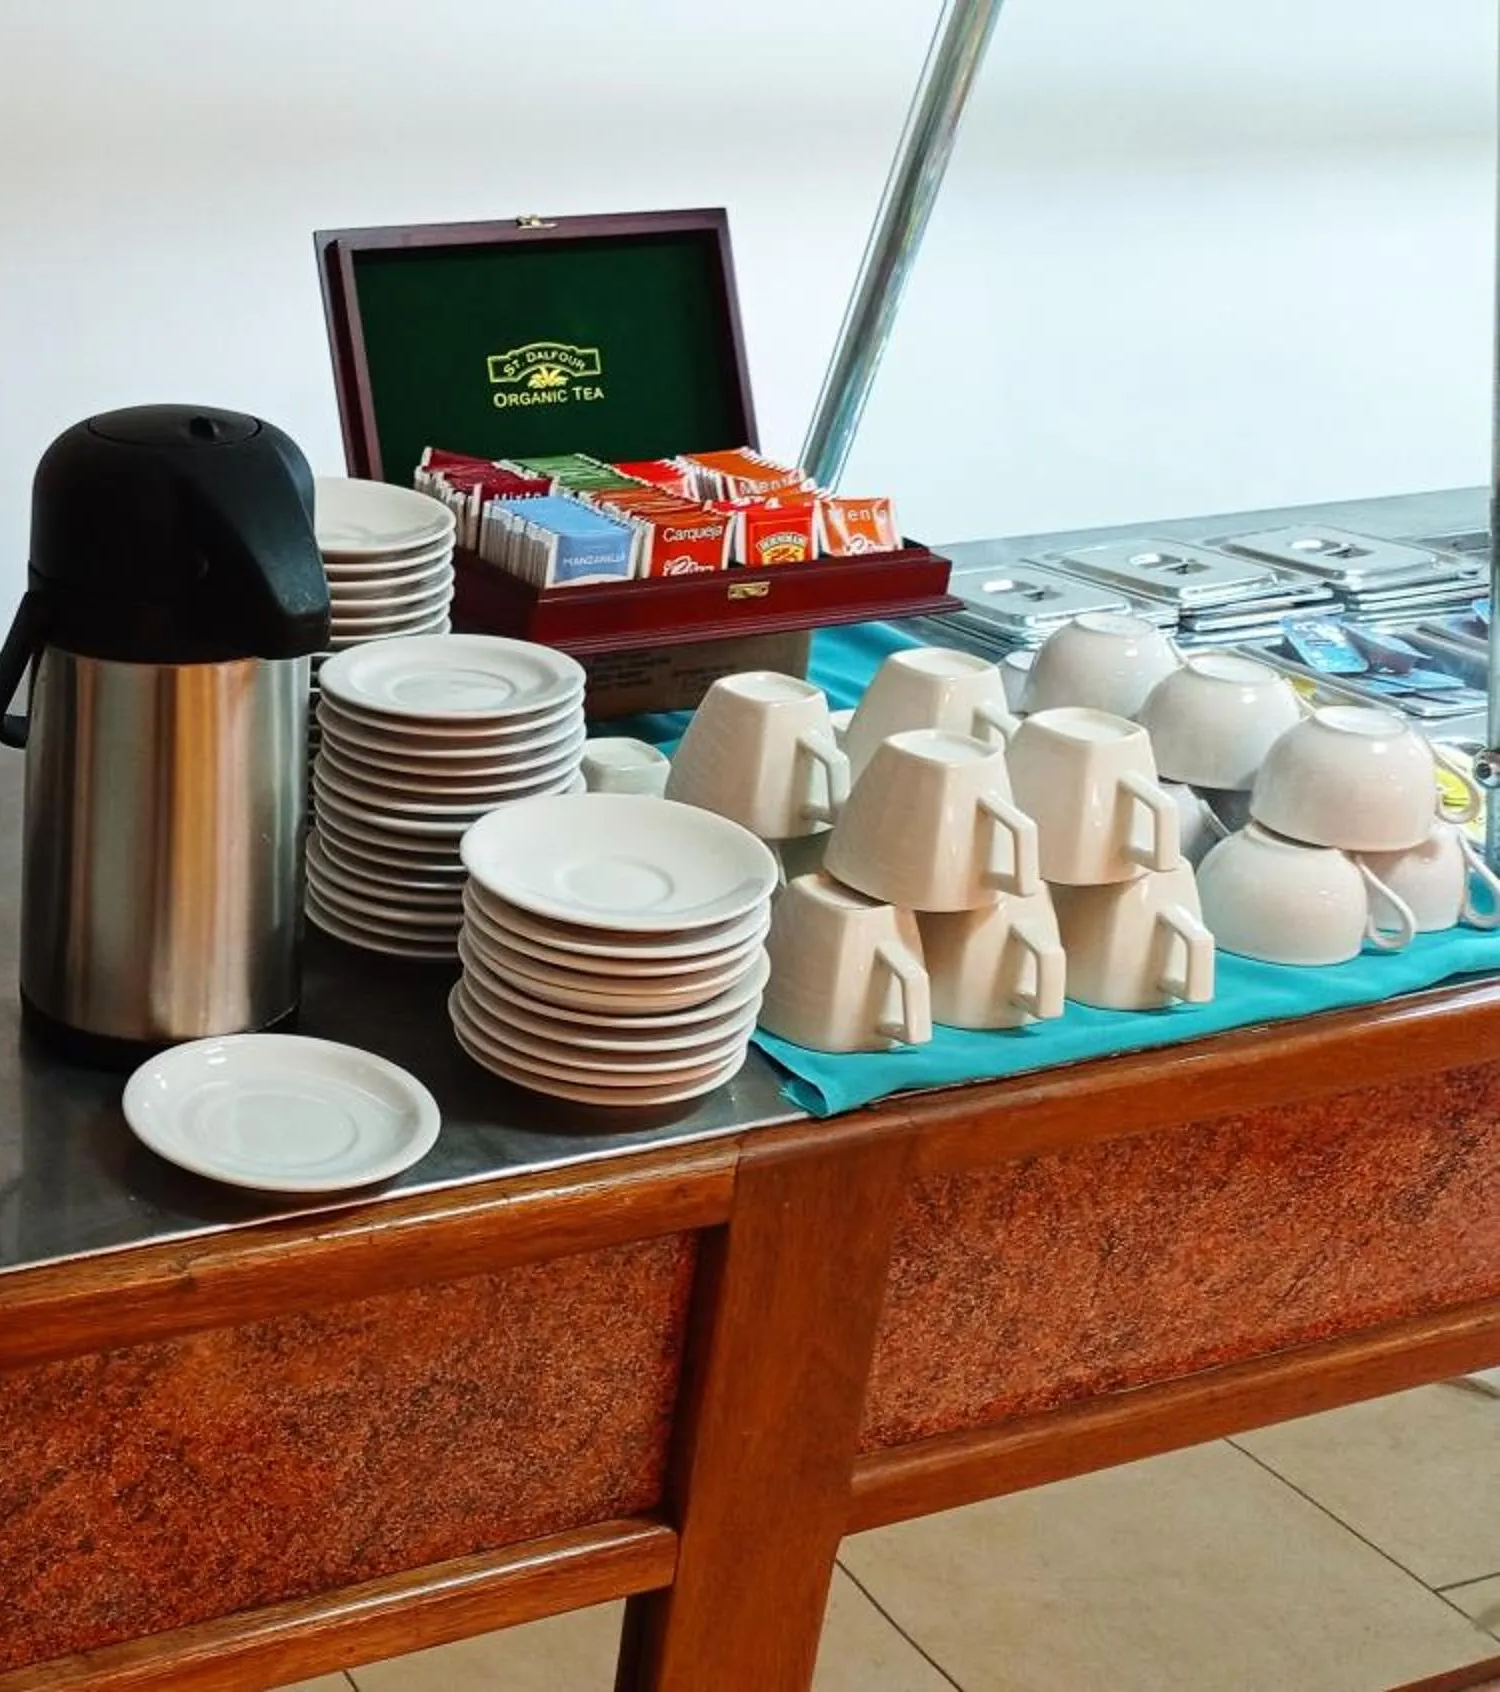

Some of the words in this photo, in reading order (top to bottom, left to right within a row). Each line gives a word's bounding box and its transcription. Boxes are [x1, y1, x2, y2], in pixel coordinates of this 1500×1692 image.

[525, 350, 586, 370] DALFOUR
[493, 389, 568, 408] ORGANIC
[572, 386, 605, 401] TEA
[663, 525, 723, 542] Carqueja
